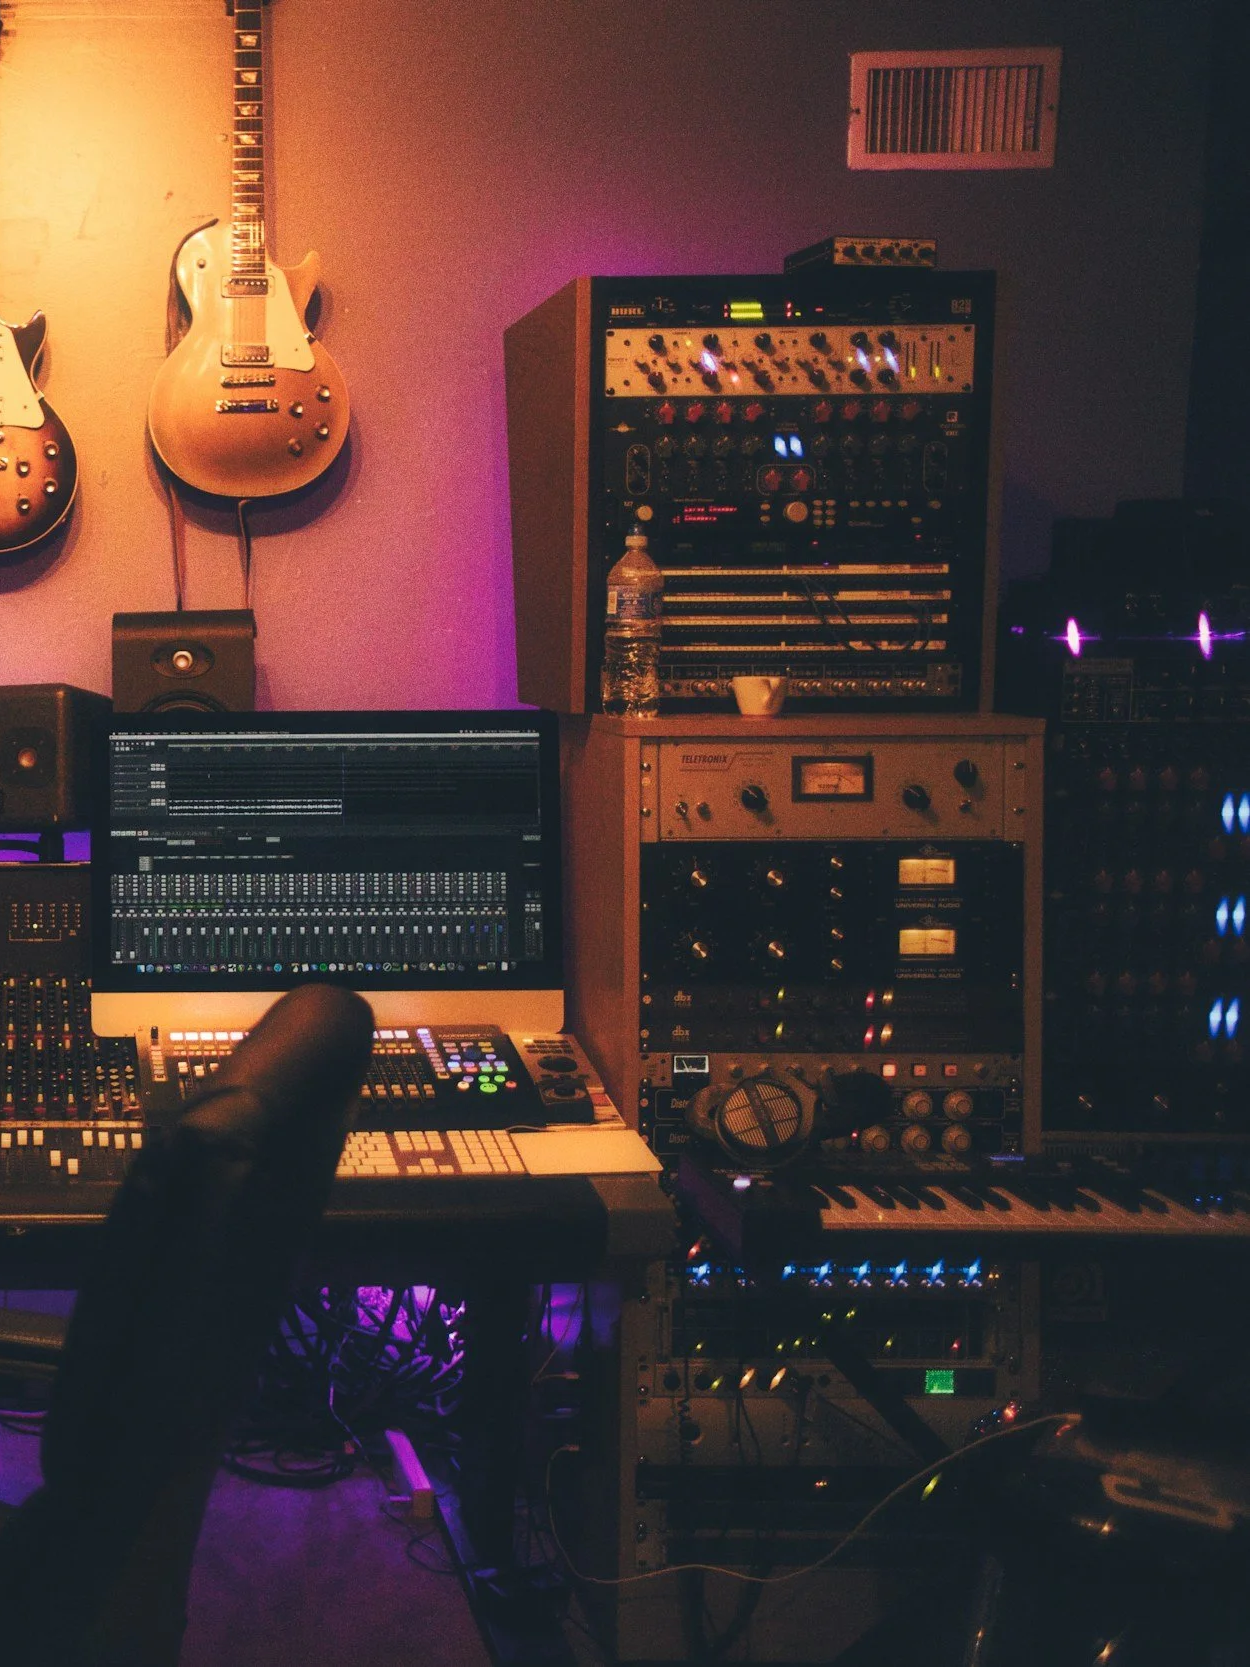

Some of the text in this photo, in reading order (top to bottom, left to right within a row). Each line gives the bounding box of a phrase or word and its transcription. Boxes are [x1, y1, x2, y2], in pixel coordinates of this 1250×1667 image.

[681, 755, 728, 764] TELETRONIX
[674, 990, 692, 1002] dbx
[672, 1025, 690, 1036] dbx
